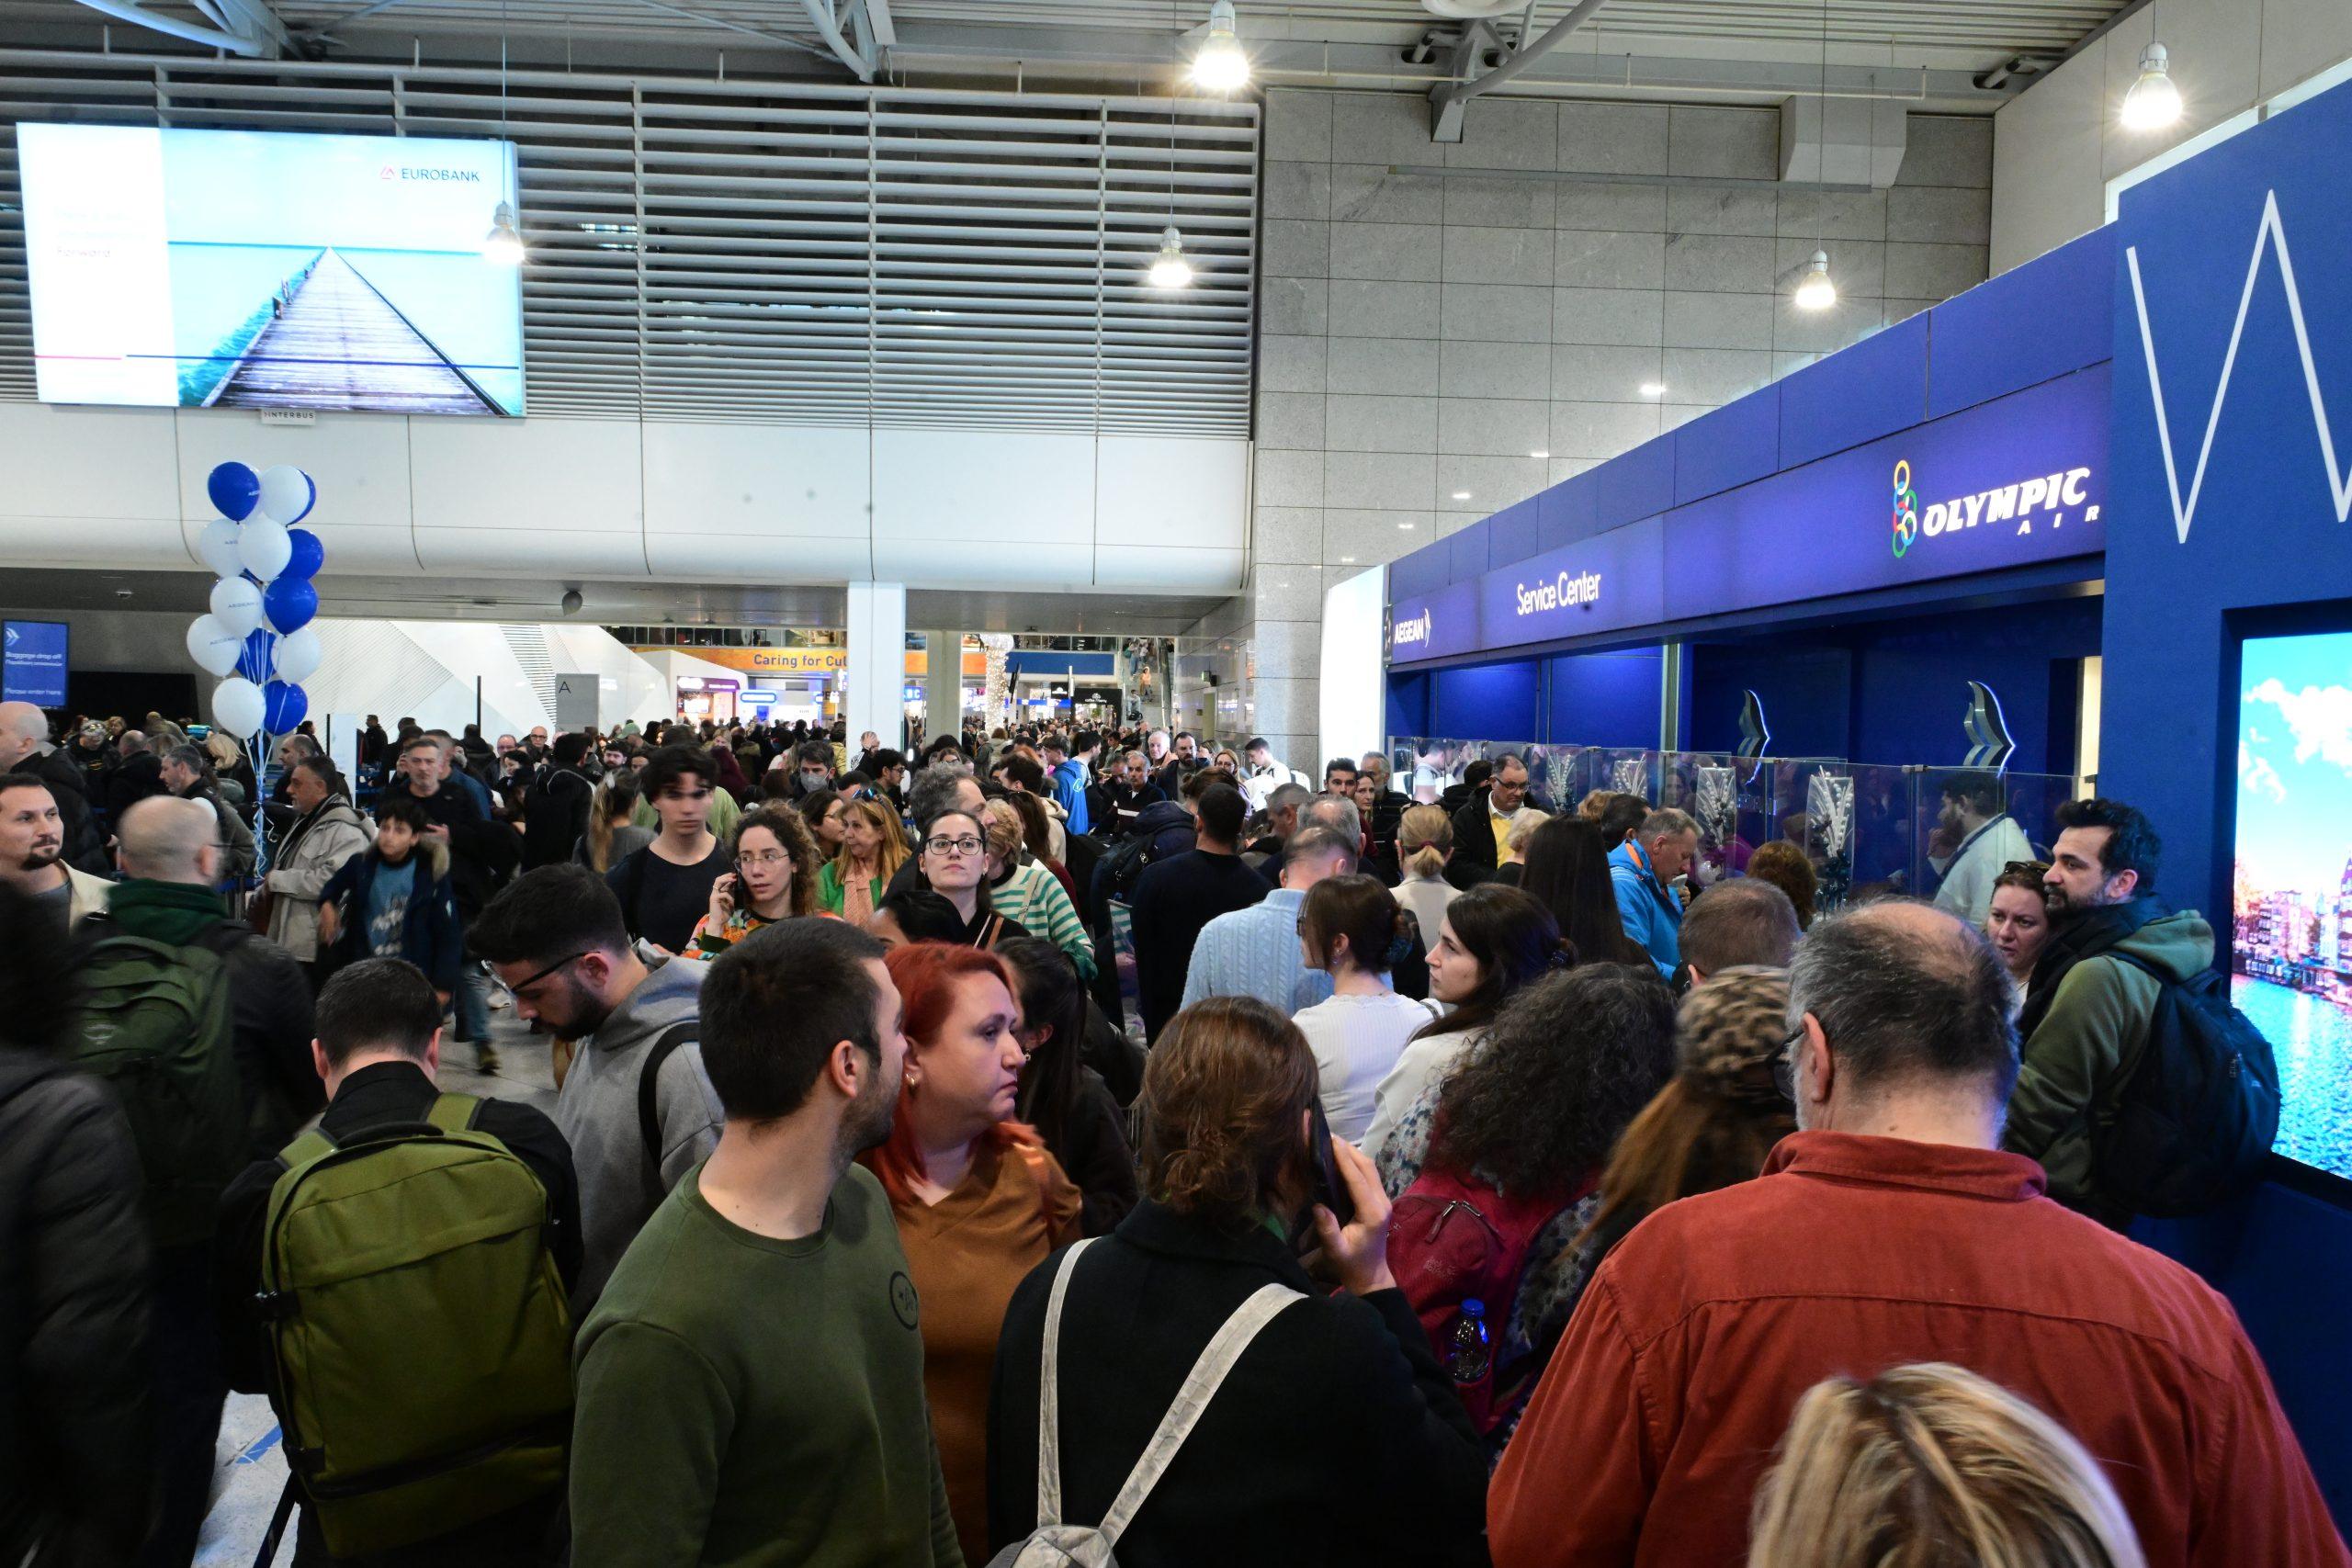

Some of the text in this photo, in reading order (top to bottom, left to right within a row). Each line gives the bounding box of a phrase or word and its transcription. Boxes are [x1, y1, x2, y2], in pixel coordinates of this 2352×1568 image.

[401, 167, 480, 182] EUROBANK
[1922, 467, 2091, 537] OLYMPIC
[2017, 504, 2100, 536] AIR
[1517, 570, 1601, 615] Service Center
[1394, 617, 1424, 645] AEGEAN
[753, 654, 797, 669] Caring
[802, 655, 821, 666] for
[559, 681, 571, 694] A
